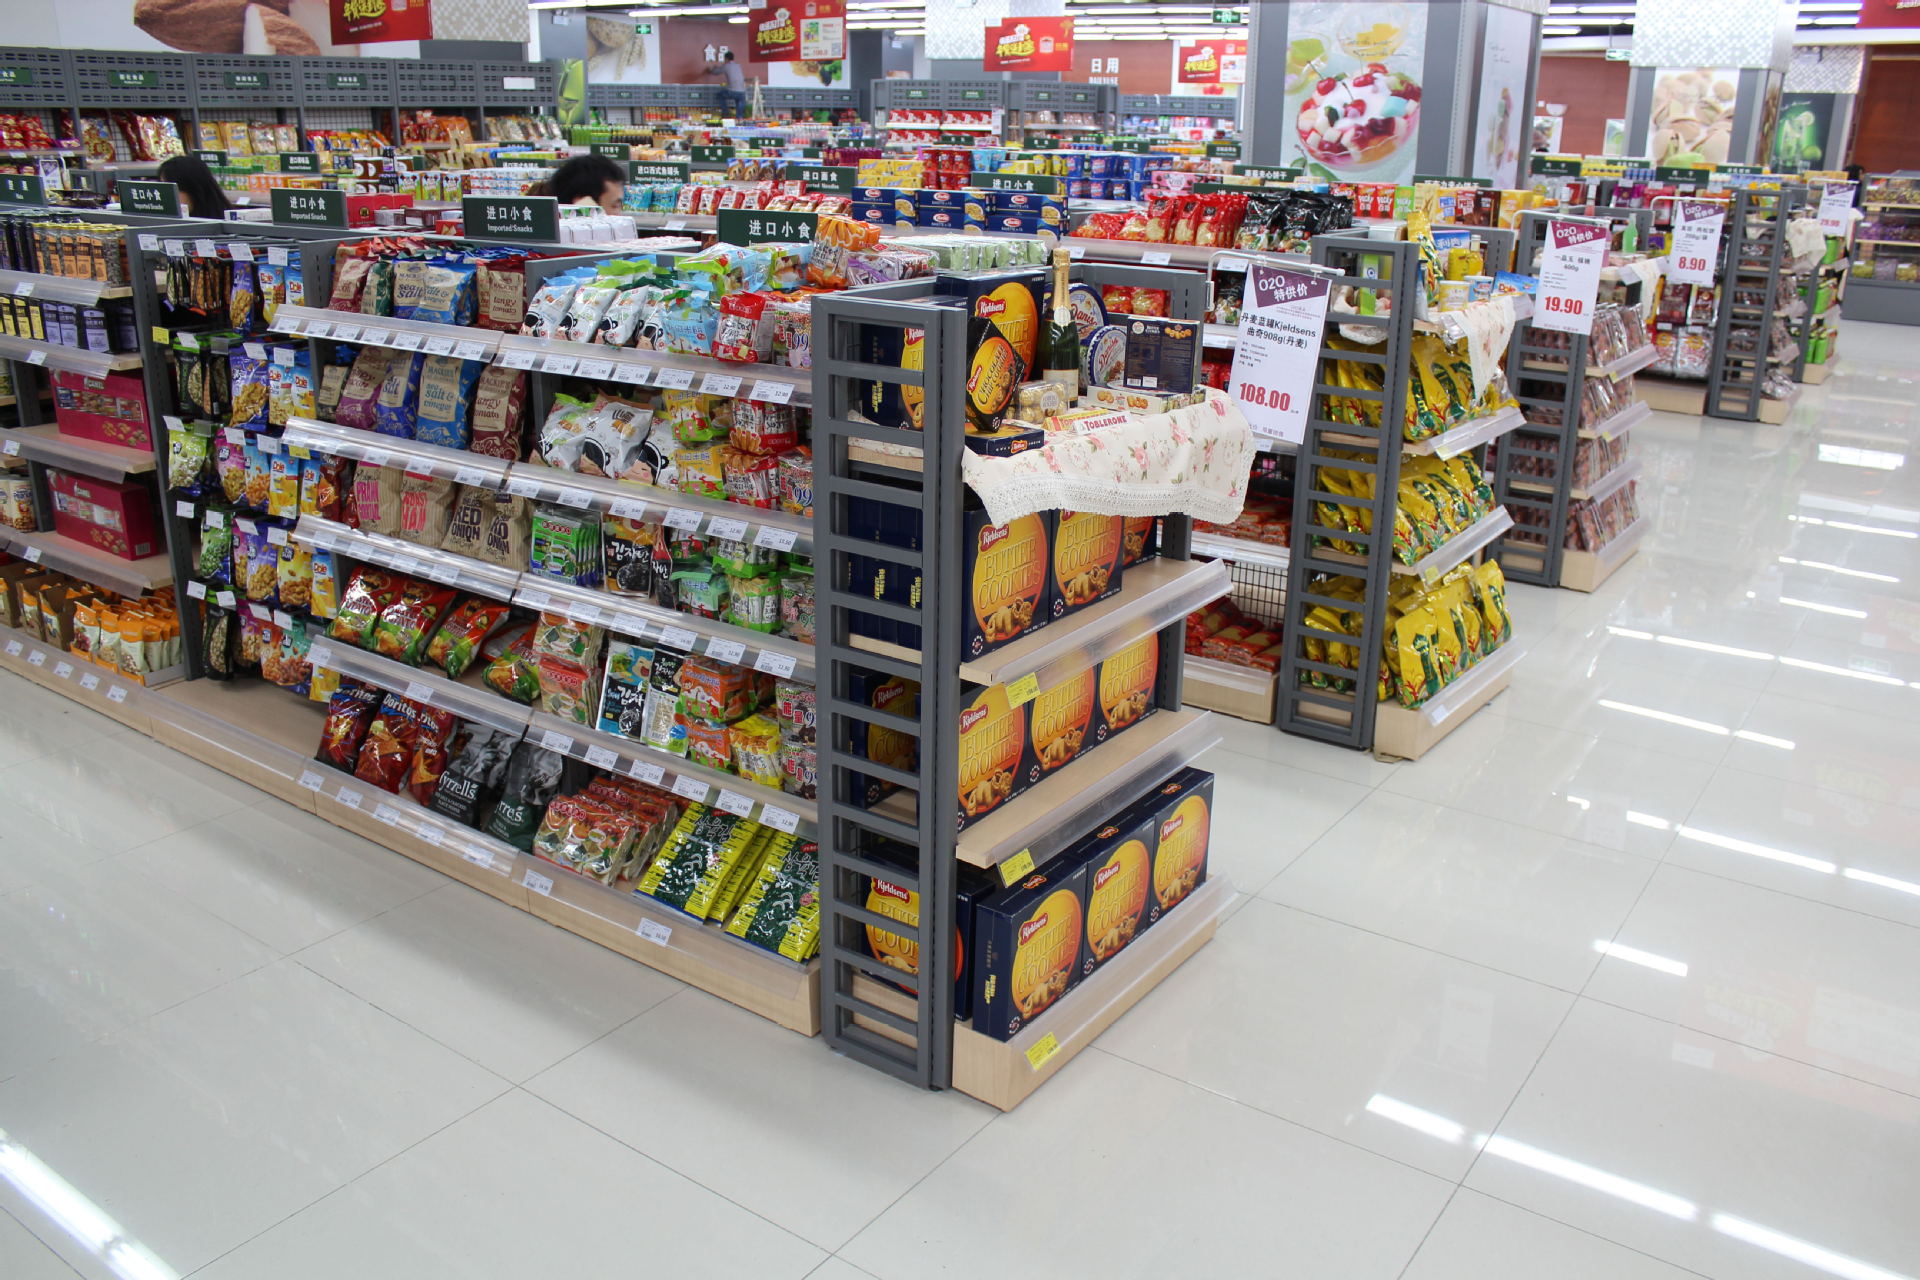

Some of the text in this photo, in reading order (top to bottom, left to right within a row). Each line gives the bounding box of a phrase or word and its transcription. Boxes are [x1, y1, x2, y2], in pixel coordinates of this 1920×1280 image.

[1092, 58, 1120, 74] 日用
[637, 165, 680, 177] 进口西式鱼罐头
[803, 170, 839, 182] 进口面食
[993, 178, 1034, 191] 进口小食
[130, 187, 162, 202] 进口小食
[288, 194, 327, 212] 进口小食
[290, 213, 310, 222] Imported
[486, 204, 533, 221] 进口小食
[487, 224, 534, 233] Imported Snacks
[749, 220, 811, 239] 进口小食
[1568, 231, 1594, 245] 特供价
[1678, 256, 1706, 271] 8.90
[260, 272, 274, 284] Dole
[289, 281, 303, 293] Dole
[396, 287, 425, 300] salt
[398, 284, 415, 294] sea
[1273, 283, 1308, 302] 特供价
[492, 296, 517, 308] tangy
[492, 305, 517, 315] tomato
[980, 301, 1005, 314] Kjeldsens
[1544, 296, 1584, 315] 19.90
[1240, 311, 1317, 338] 丹麦蓝罐Kjeldsens
[1247, 326, 1308, 349] 曲奇908g(丹麦)
[269, 370, 282, 381] Dole
[428, 366, 455, 377] MACKIE'S
[977, 343, 1008, 406] CHOCOLATE
[295, 375, 308, 388] Dole
[424, 387, 444, 400] salt
[1240, 383, 1291, 412] 108.00
[1083, 415, 1128, 430] TOBLERONE
[272, 461, 286, 472] Dole
[454, 505, 482, 526] RED
[451, 522, 481, 543] ONION
[982, 524, 1009, 544] Kjeldsens
[611, 540, 650, 564] 김자반
[983, 535, 1037, 578] BUTTER
[1058, 536, 1115, 572] COOKIES
[313, 563, 328, 574] Dole
[977, 560, 1041, 610] COOKIES
[876, 683, 905, 705] Kjeldsens
[383, 693, 417, 720] Doritos
[960, 705, 987, 727] Kjeldsens
[1036, 699, 1089, 739] COOKIES
[963, 713, 1016, 756] BUTTER
[959, 738, 1019, 789] COOKIES
[1162, 815, 1184, 838] Kjeldsens
[1161, 824, 1200, 858] BUTTER
[1158, 840, 1201, 878] COOKIES
[1097, 862, 1120, 887] Kjeldsens
[875, 878, 909, 901] Kjeldsens
[1099, 873, 1140, 912] BUTTER
[1091, 893, 1142, 937] COOKIES
[1021, 913, 1048, 939] Kjeldsens
[1023, 912, 1074, 967] BUTTER
[1018, 931, 1077, 990] COOKIES
